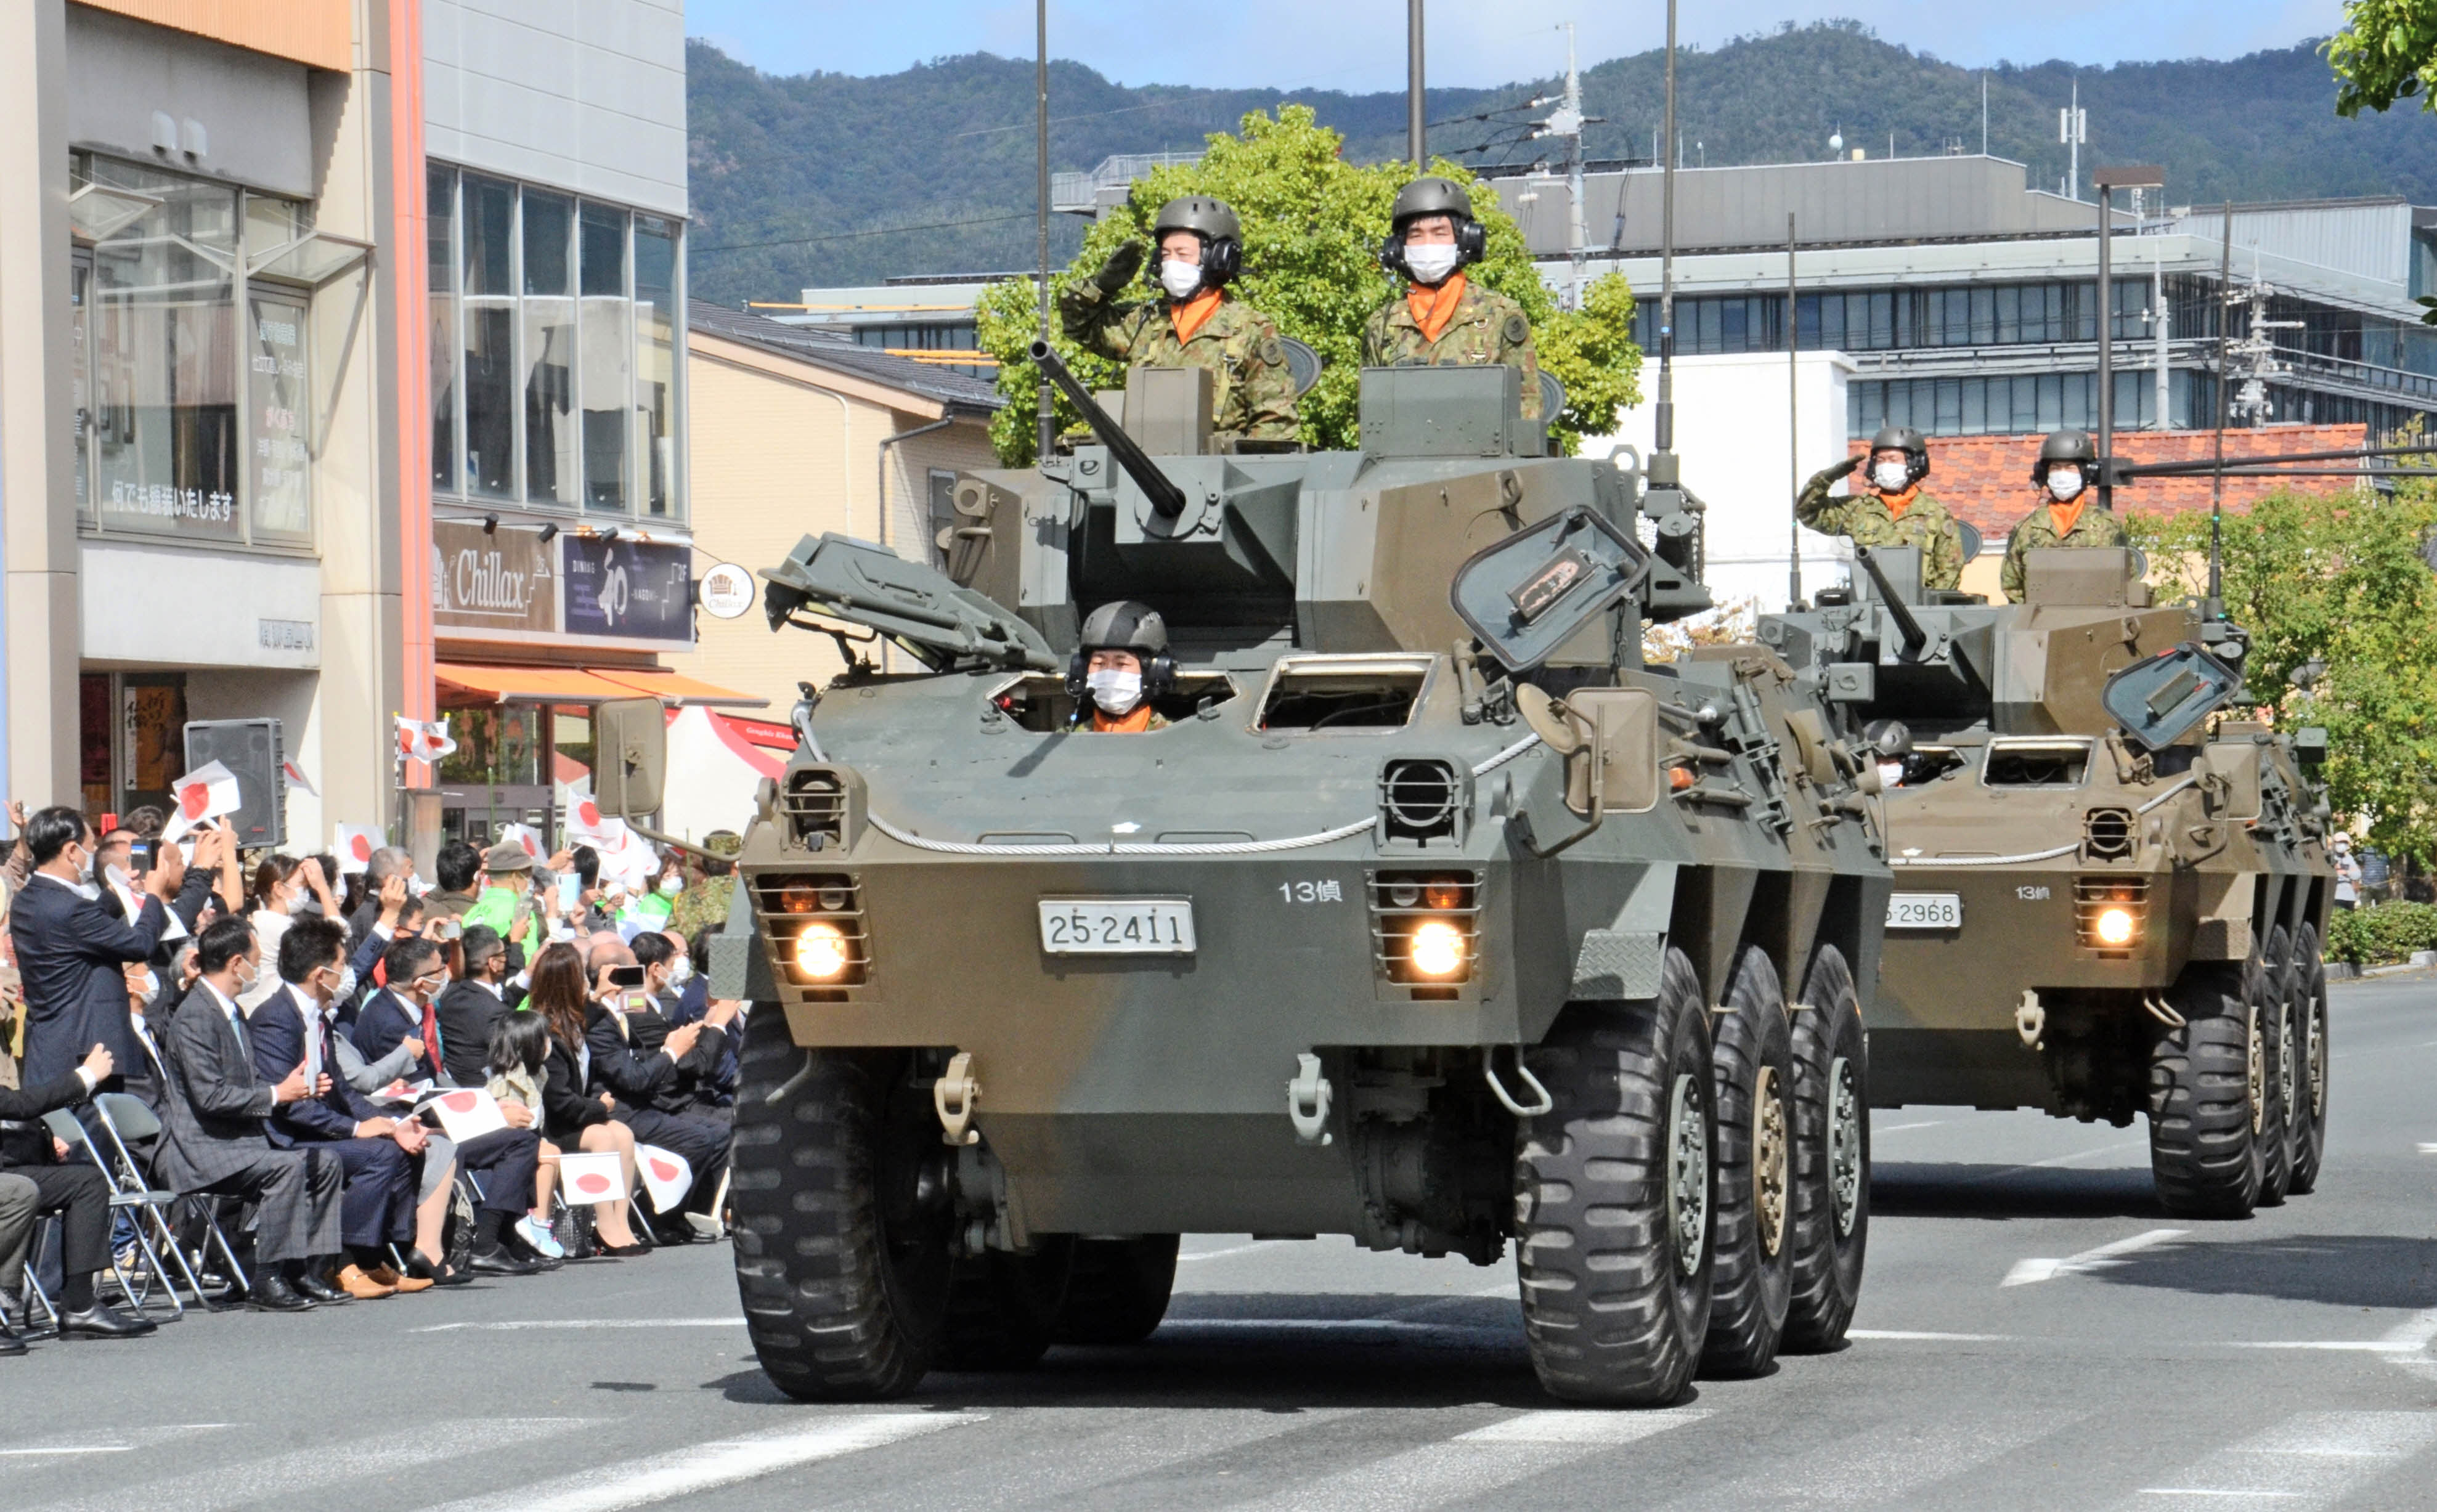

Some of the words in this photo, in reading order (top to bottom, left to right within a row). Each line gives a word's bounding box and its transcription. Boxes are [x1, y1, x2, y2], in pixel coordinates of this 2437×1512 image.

[112, 480, 232, 522] 何でも額装いたします
[457, 548, 524, 609] Chillax
[678, 564, 687, 582] 2F
[1279, 880, 1343, 903] 13偵
[1049, 916, 1182, 944] 25-2411
